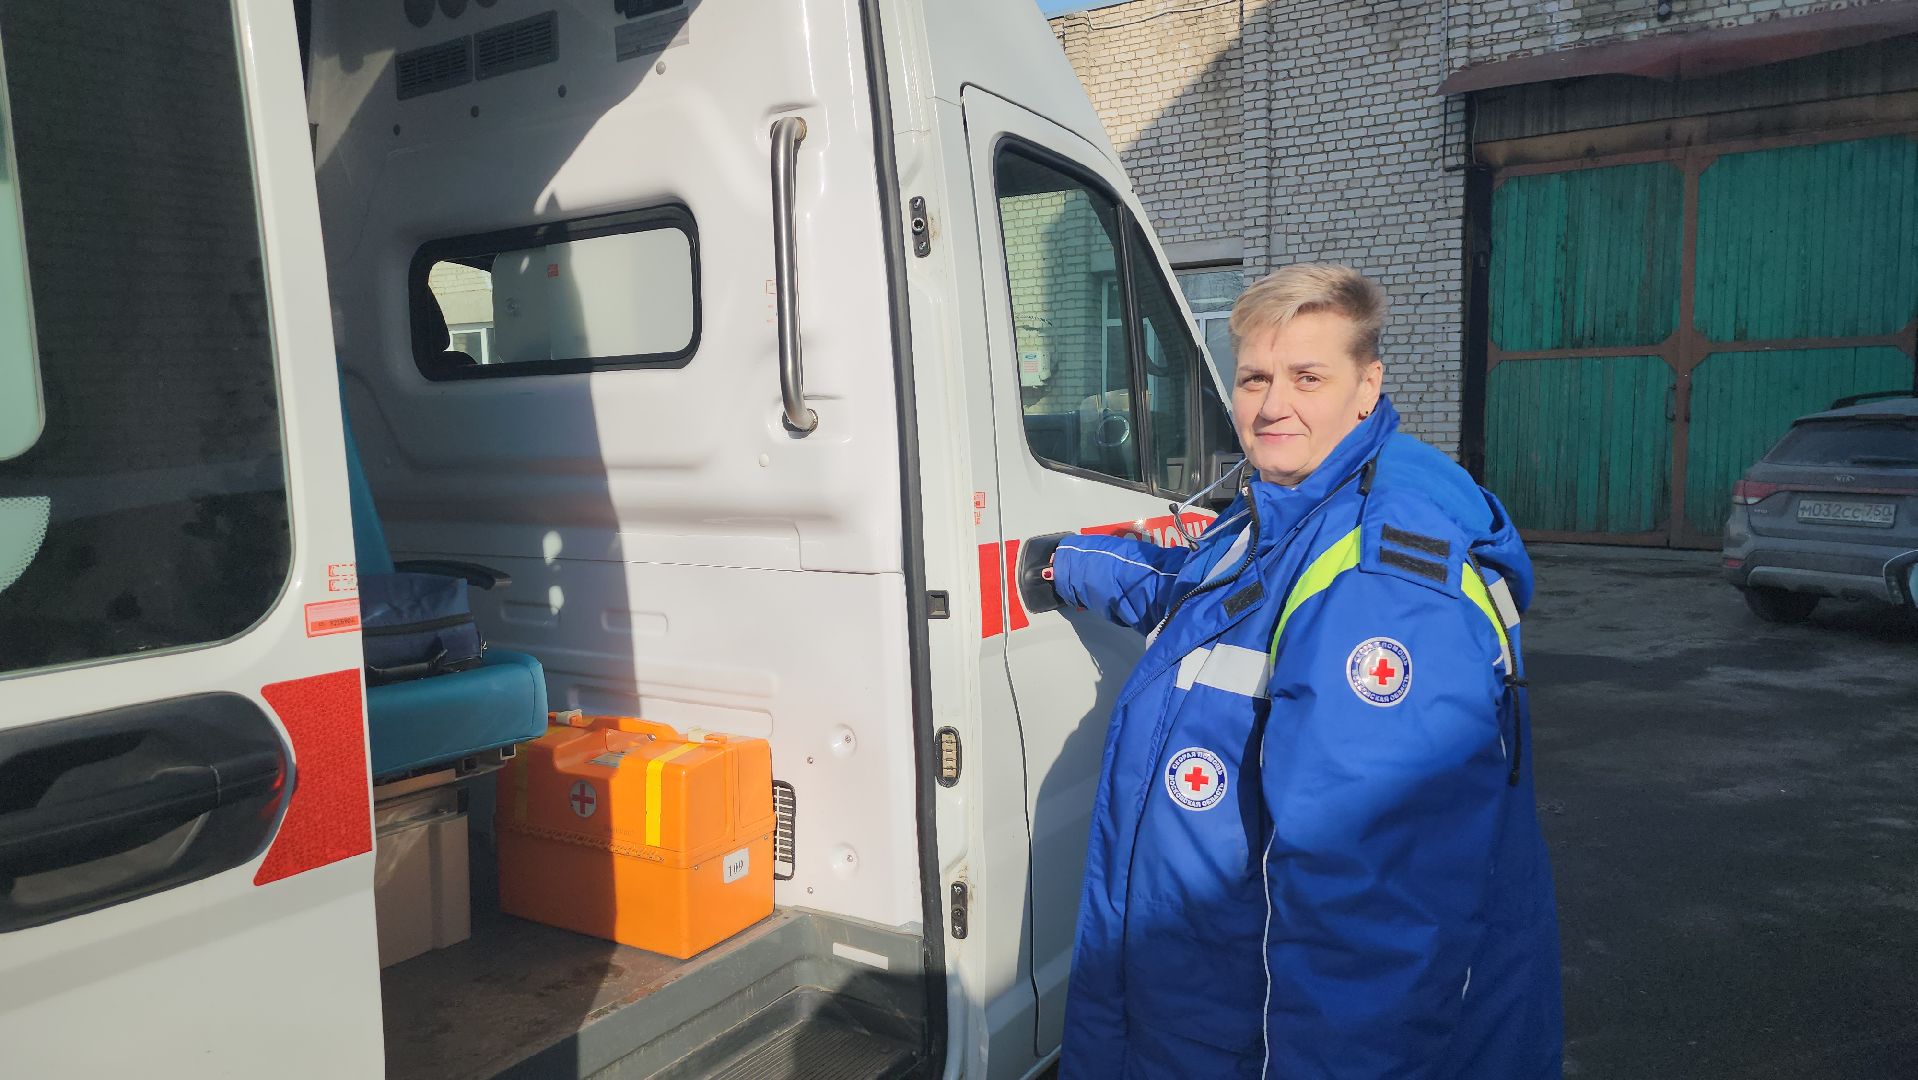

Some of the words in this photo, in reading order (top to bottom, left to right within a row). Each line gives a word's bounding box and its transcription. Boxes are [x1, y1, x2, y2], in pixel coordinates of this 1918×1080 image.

[1381, 642, 1408, 666] ПОМОЩЬ
[1172, 752, 1196, 769] СКОРАЯ
[1197, 752, 1223, 775] ПОМОЩЬ
[1169, 775, 1201, 808] МОСКОВСКАЯ
[1202, 783, 1224, 807] ОБЛАСТЬ
